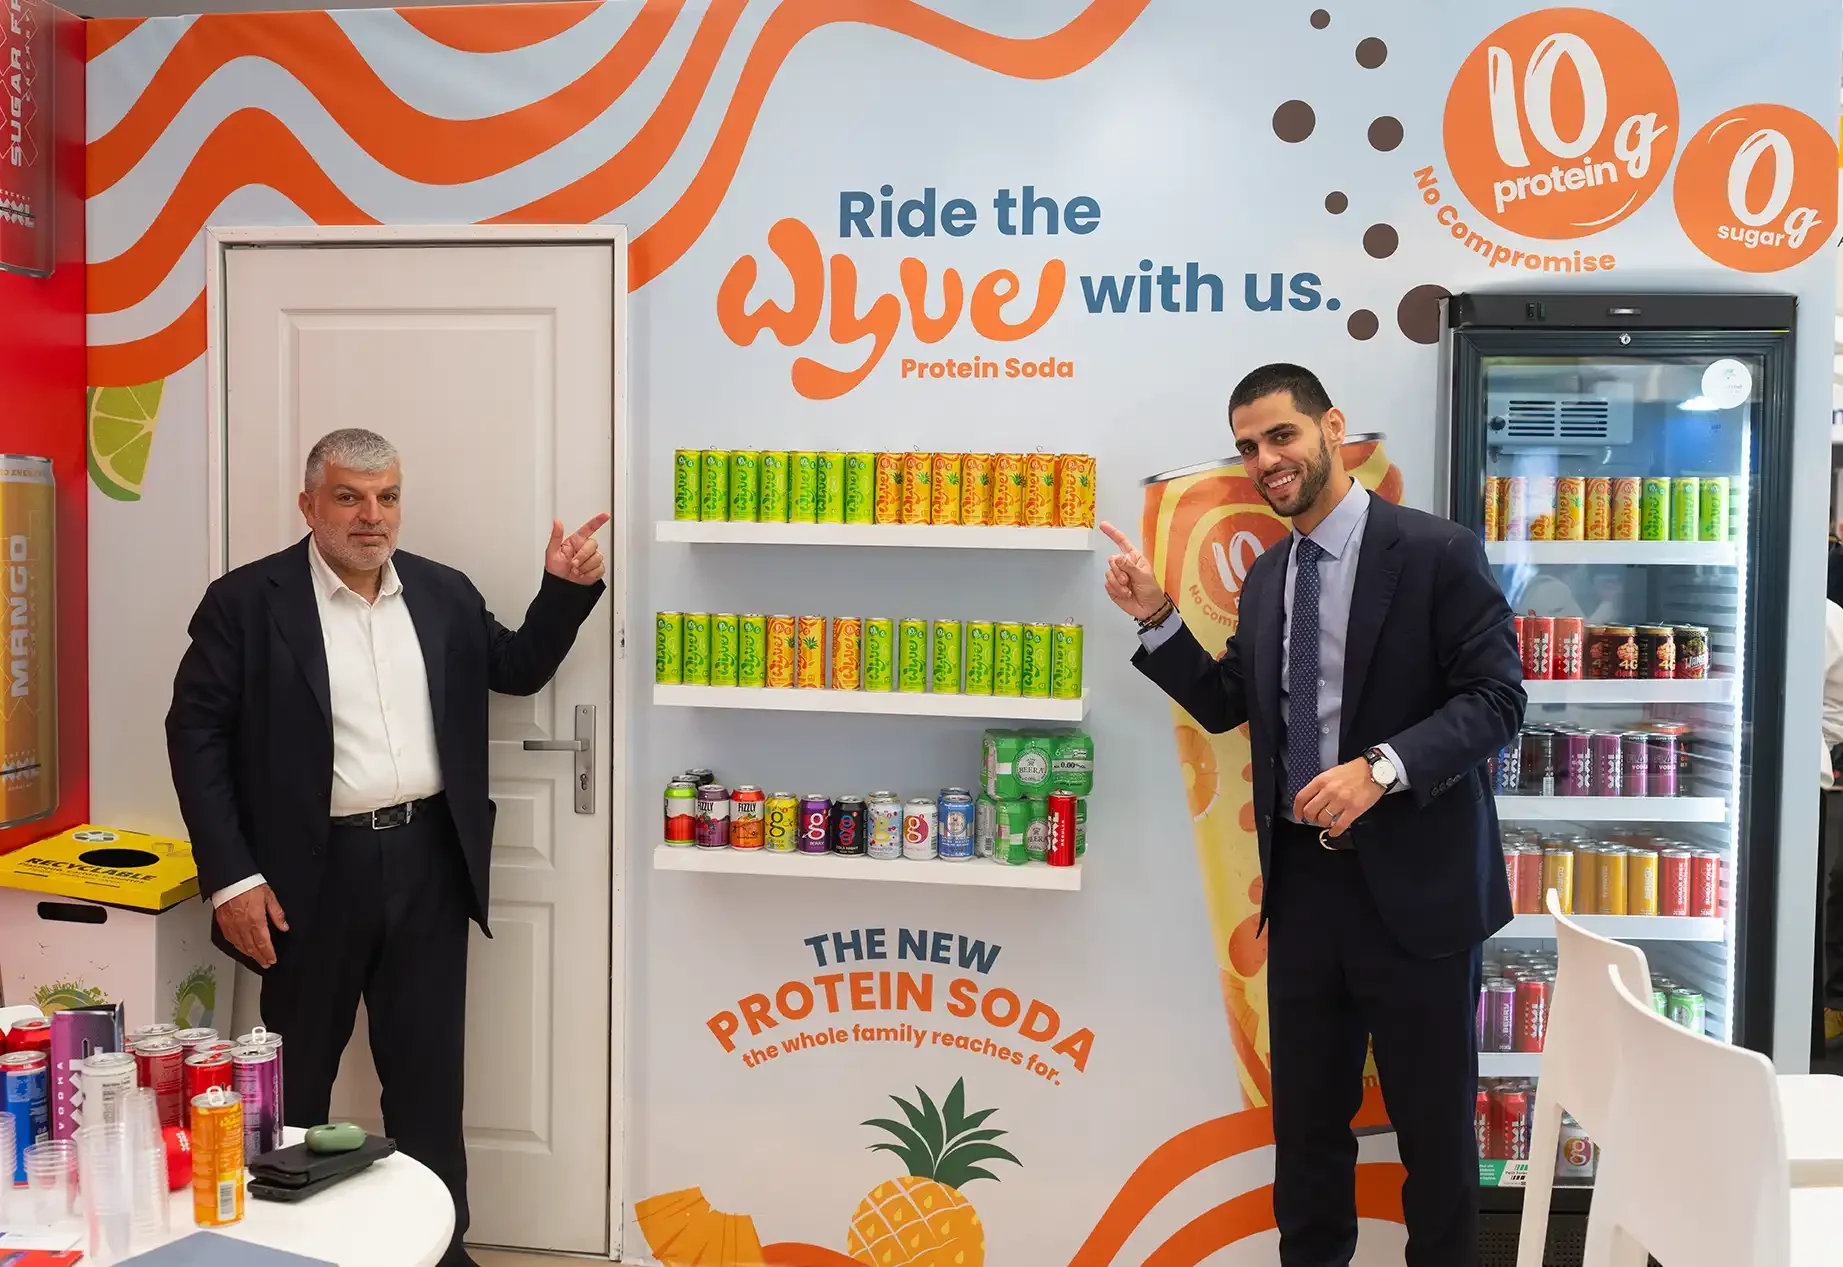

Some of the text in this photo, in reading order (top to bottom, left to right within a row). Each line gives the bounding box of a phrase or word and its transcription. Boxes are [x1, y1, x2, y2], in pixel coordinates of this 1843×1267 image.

[11, 48, 22, 168] SUGAR
[838, 185, 1101, 239] Ride the
[1493, 157, 1619, 213] protein
[1412, 165, 1617, 274] No Compromise
[1716, 222, 1785, 249] sugar
[1080, 258, 1342, 314] with us.
[900, 356, 1074, 379] Protein Soda
[10, 534, 29, 698] MANGO
[1188, 584, 1202, 604] No
[1619, 659, 1638, 669] 4G
[1658, 659, 1675, 670] 4G
[738, 802, 757, 813] FIZZLY
[26, 857, 157, 881] RECYCLABLE
[803, 928, 1002, 975] THE NEW
[705, 971, 1097, 1073] PROTEIN SODA
[742, 1023, 1062, 1087] the whole family reaches for.
[57, 1061, 65, 1131] VODKA
